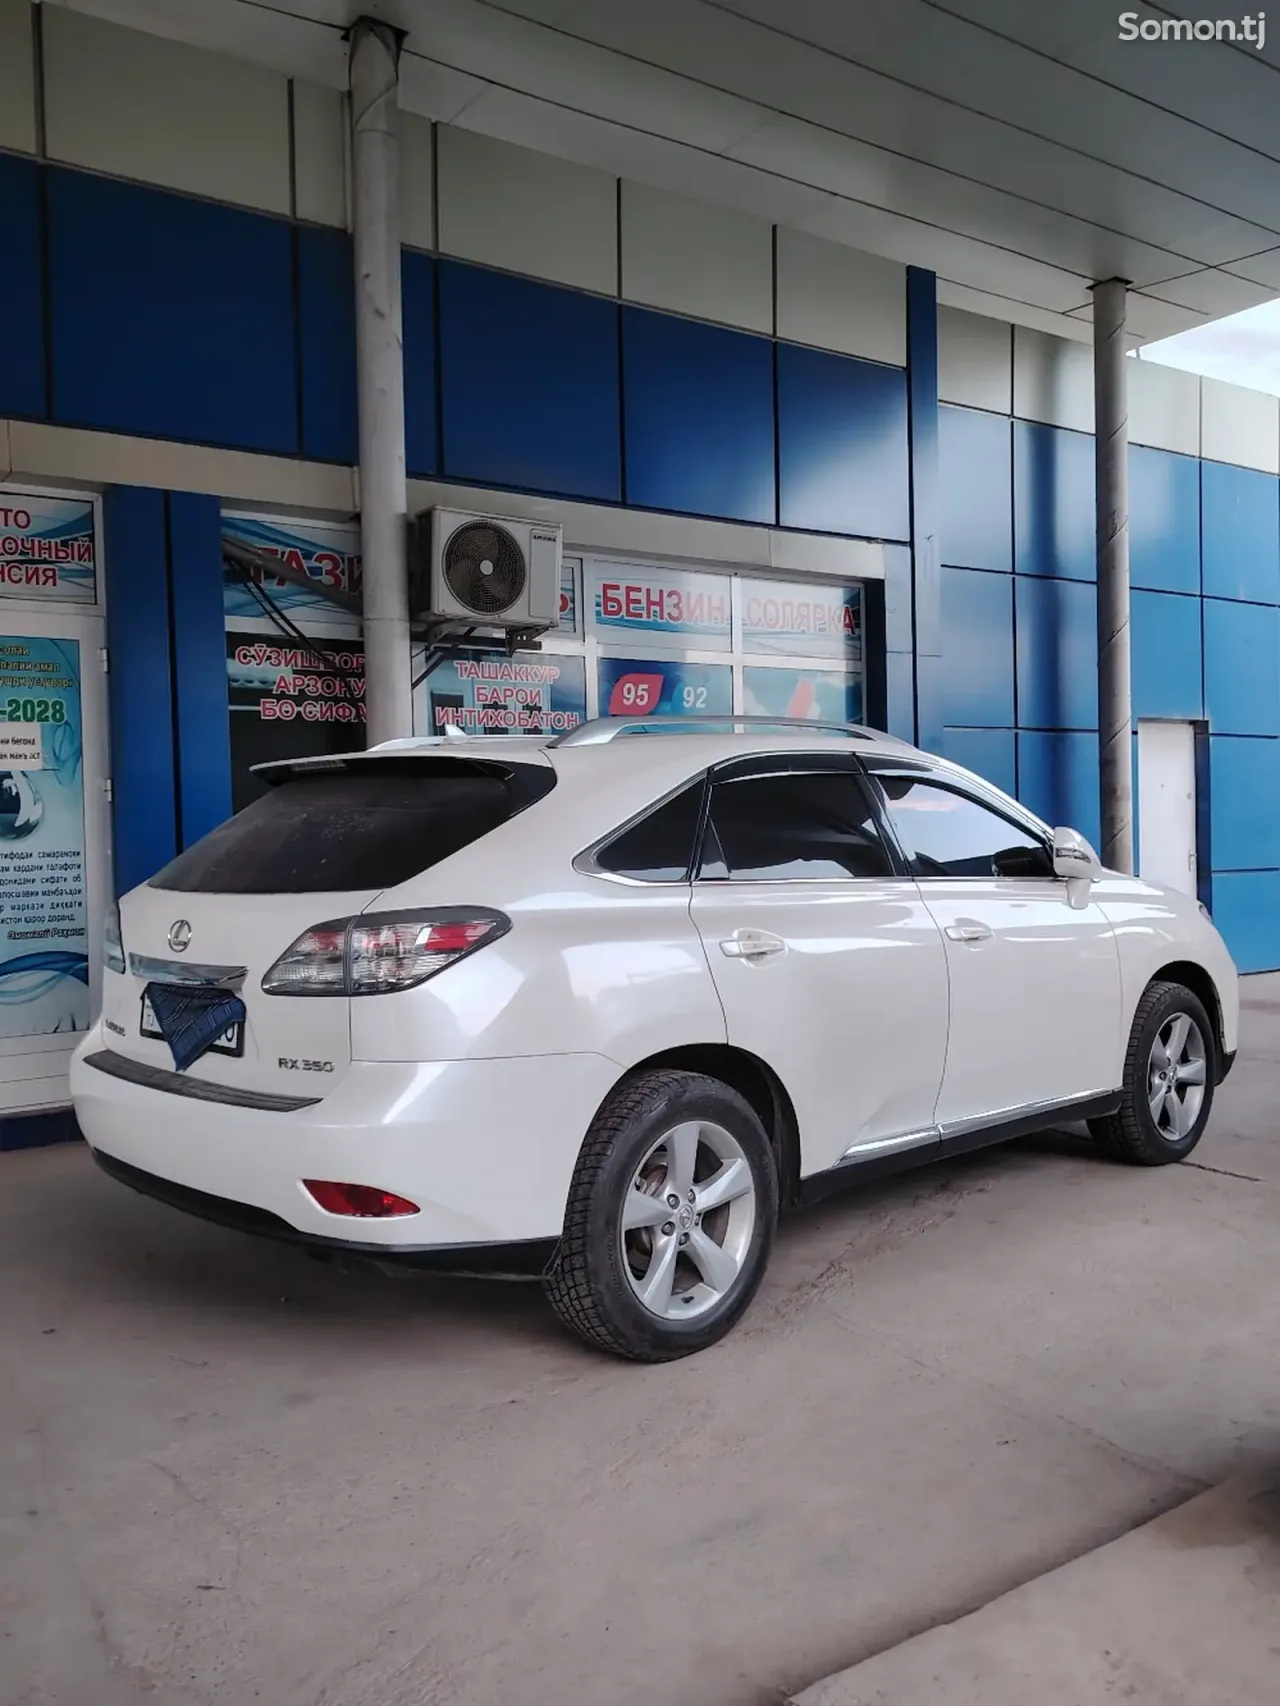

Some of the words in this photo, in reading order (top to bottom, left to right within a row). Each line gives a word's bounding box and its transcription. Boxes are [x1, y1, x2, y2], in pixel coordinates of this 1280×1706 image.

[0, 507, 32, 529] ТО
[602, 583, 725, 624] БЕНЗИН
[746, 597, 857, 636] СОЛЯРКА
[455, 661, 560, 683] ТАШАККУР
[476, 686, 541, 705] БАРОИ
[622, 682, 649, 706] 95
[682, 686, 707, 709] 92
[435, 706, 580, 730] ИНТИХОБАТОН
[278, 1057, 300, 1070] RX
[302, 1059, 335, 1073] 350
